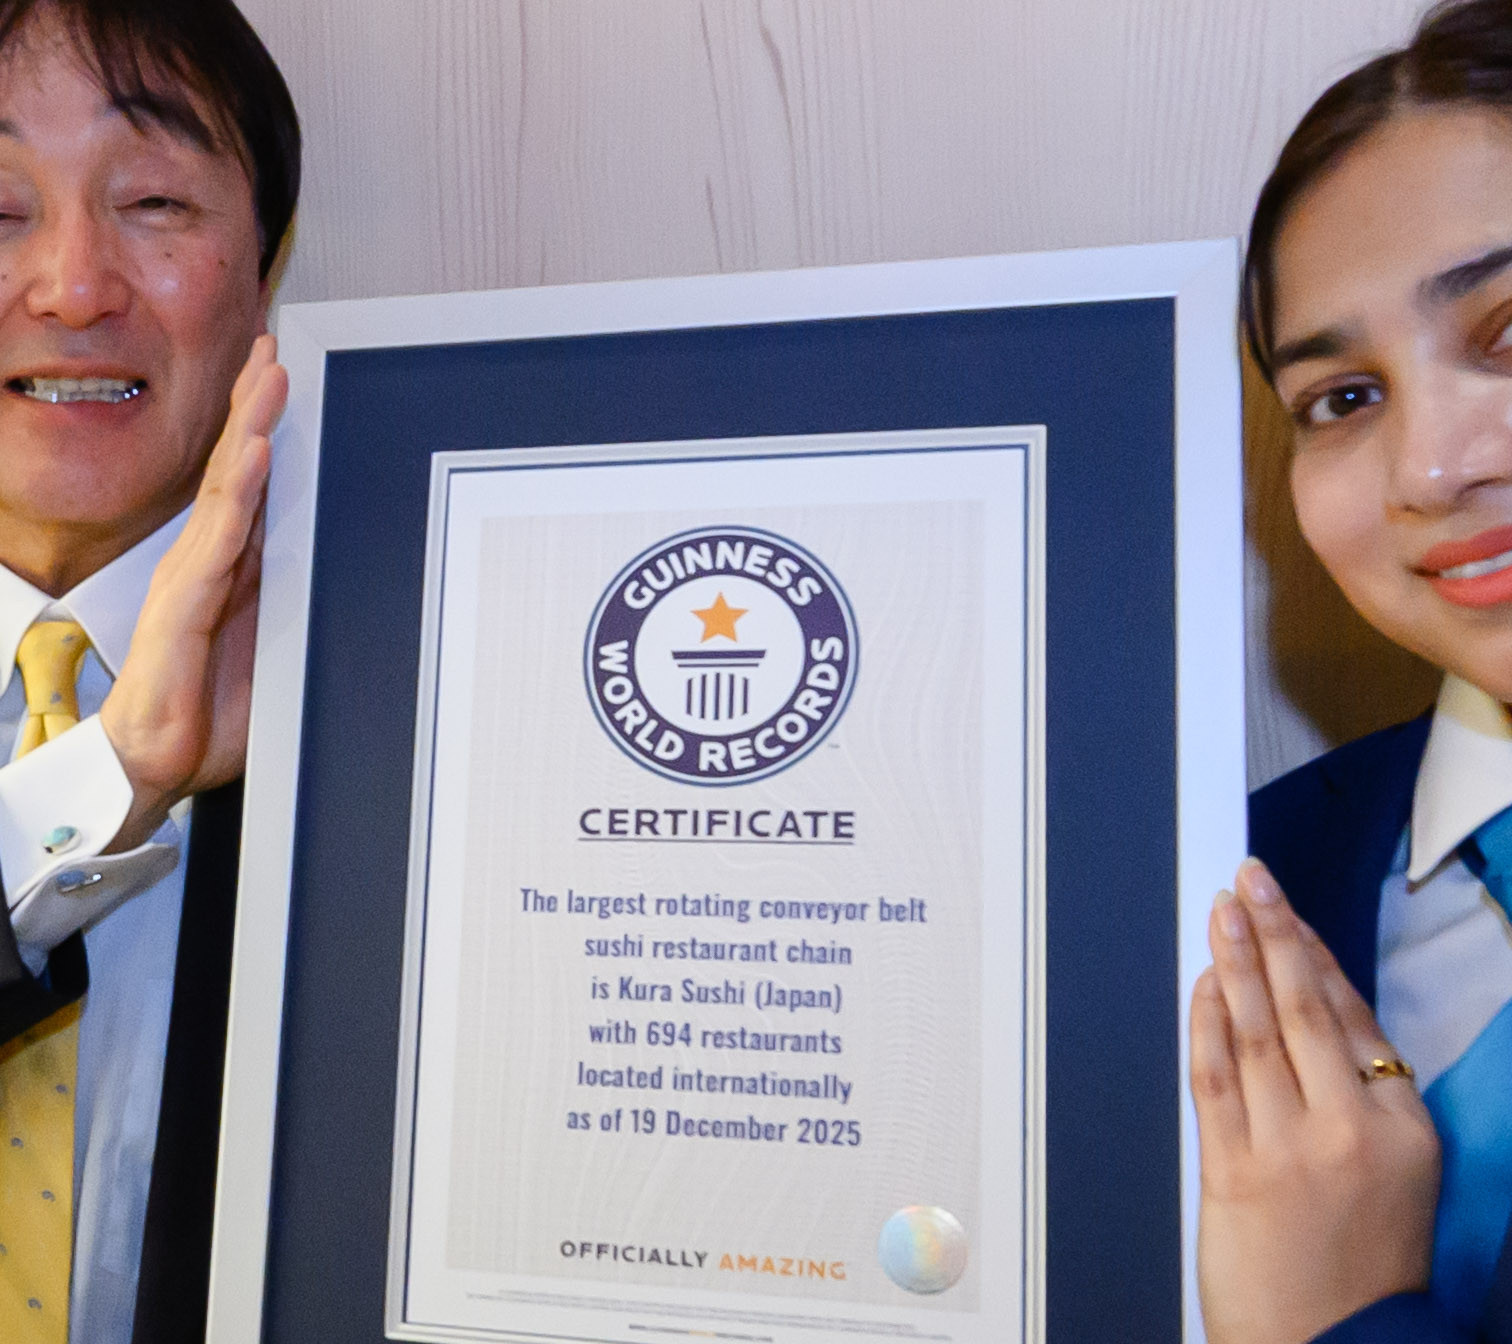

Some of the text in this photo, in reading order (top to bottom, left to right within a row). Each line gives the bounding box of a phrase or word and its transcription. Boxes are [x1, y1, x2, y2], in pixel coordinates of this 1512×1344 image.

[624, 540, 822, 611] GUINNESS
[598, 637, 843, 772] WORLD RECORDS
[578, 808, 856, 840] CERTIFICATE
[520, 888, 927, 924] The largest rotating conveyor belt
[584, 933, 853, 966] sushi restaurant chain
[591, 977, 843, 1014] is Kura Sushi (Japan)
[588, 1021, 843, 1055] with 694 restaurants
[577, 1063, 853, 1103] located internationally
[566, 1108, 862, 1147] as of 19 December 2025
[559, 1240, 847, 1281] OFFICIALLY AMAZING
